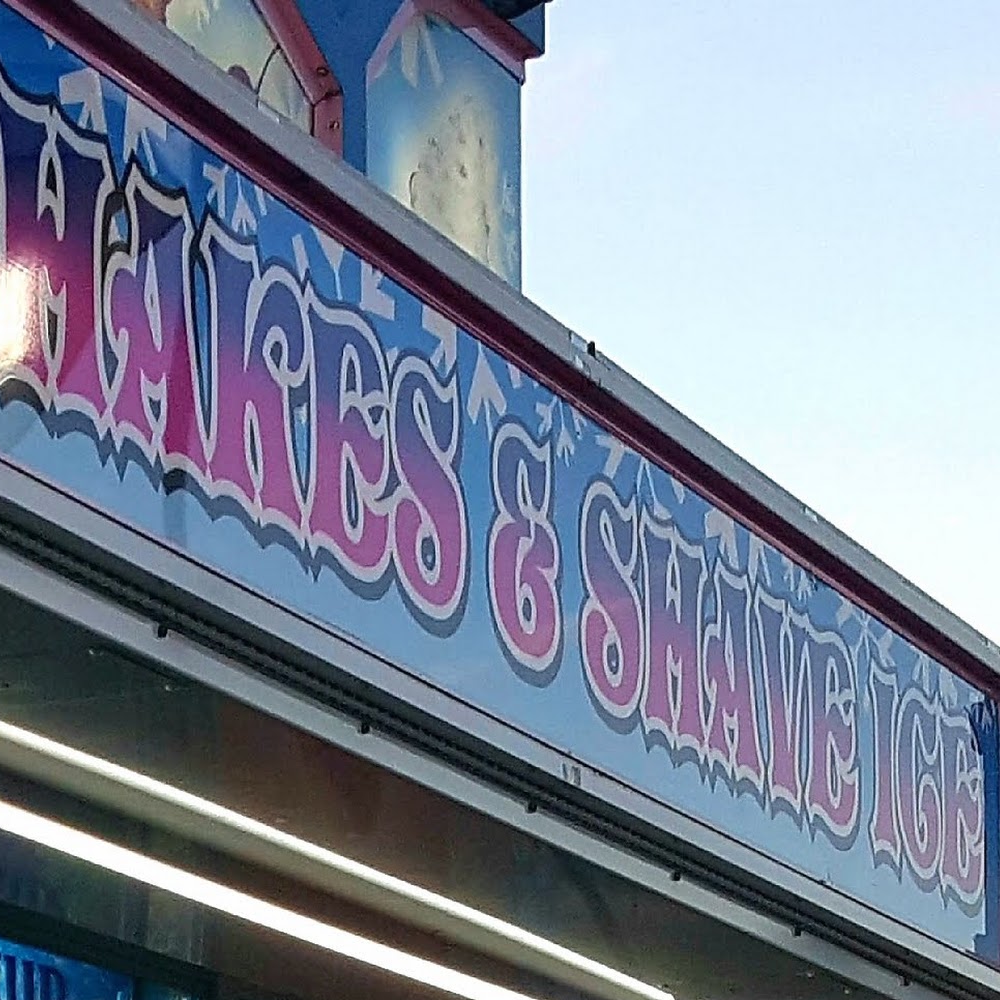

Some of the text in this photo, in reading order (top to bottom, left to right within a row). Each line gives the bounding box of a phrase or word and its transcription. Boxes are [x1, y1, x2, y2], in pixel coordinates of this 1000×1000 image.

[486, 420, 564, 686] &
[579, 475, 860, 850] SHAVE
[867, 660, 985, 916] ICE
